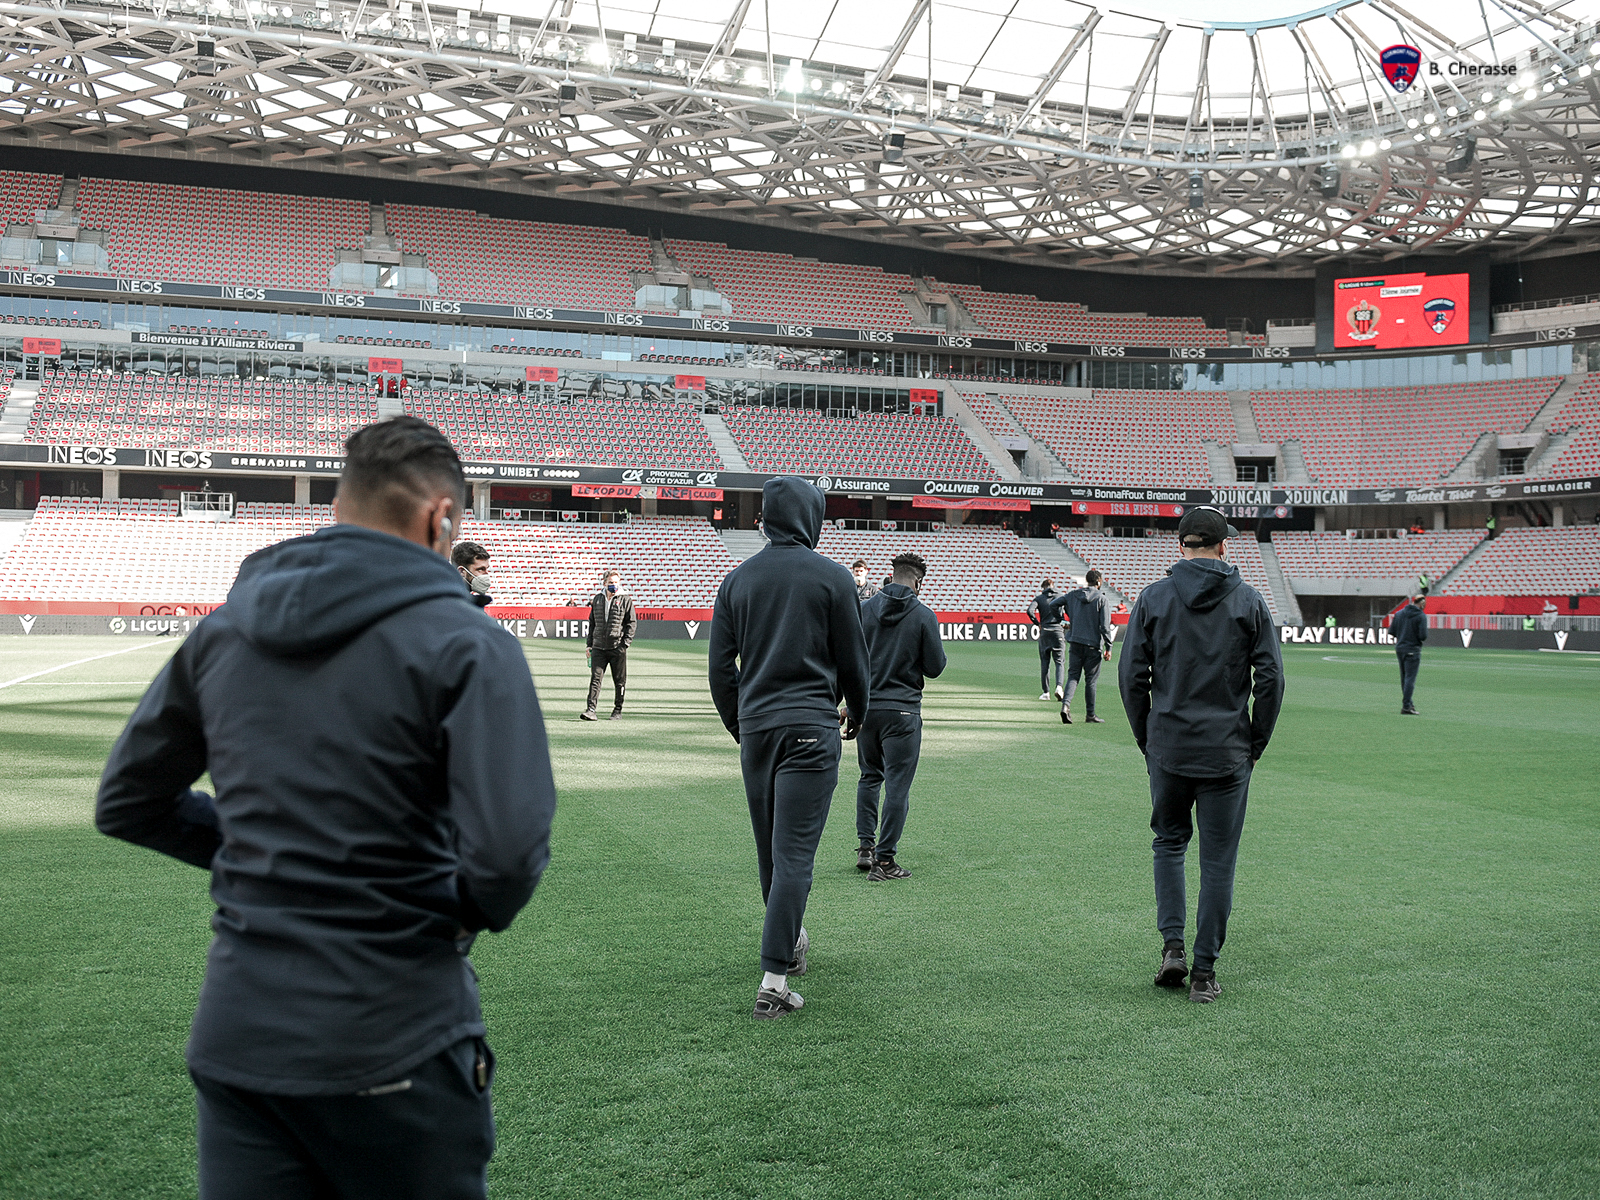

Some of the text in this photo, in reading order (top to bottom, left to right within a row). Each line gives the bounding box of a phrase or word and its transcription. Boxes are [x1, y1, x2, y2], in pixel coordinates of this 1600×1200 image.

[8, 272, 56, 287] INEOS
[116, 279, 163, 293] INEOS
[221, 286, 266, 300] INEOS
[322, 293, 365, 307] INEOS
[419, 300, 461, 314] INEOS
[513, 307, 553, 320] INEOS
[604, 312, 643, 326] INEOS
[692, 318, 730, 331] INEOS
[776, 324, 813, 337] INEOS
[858, 330, 894, 343] INEOS
[1536, 327, 1576, 341] INEOS
[139, 333, 296, 350] Bienvenue à l'Allianz Riviera
[937, 336, 972, 348] INEOS
[1014, 341, 1048, 353] INEOS
[1090, 345, 1125, 357] INEOS
[1170, 347, 1206, 359] INEOS
[1252, 347, 1290, 358] INEOS
[47, 445, 117, 465] INEOS
[144, 449, 213, 469] INEOS
[231, 457, 307, 468] GRENADIER
[500, 466, 540, 478] UNIBET
[650, 470, 690, 478] PROVENCE
[645, 475, 694, 485] CÔTE D'AZUR
[834, 478, 890, 491] Assurance
[577, 486, 591, 494] LE
[593, 487, 615, 495] KOP
[617, 488, 633, 496] DU
[935, 483, 980, 494] OLLIVIER
[1000, 486, 1044, 496] OLLIVIER
[1095, 488, 1145, 500] Bonnaffoux
[1523, 481, 1592, 494] GRENADIER
[1218, 490, 1271, 504] DUNCAN
[1293, 490, 1348, 504] DUNCAN
[1405, 488, 1477, 502] Tourtel Twist
[1110, 503, 1160, 515] ISSA NISSA
[1231, 506, 1259, 518] 1947
[131, 619, 190, 632] LIGUE 1
[533, 620, 547, 638] A
[939, 623, 1041, 640] LIKE A HERO
[1281, 626, 1326, 643] PLAY
[1328, 627, 1364, 644] LIKE
[1366, 627, 1376, 644] A
